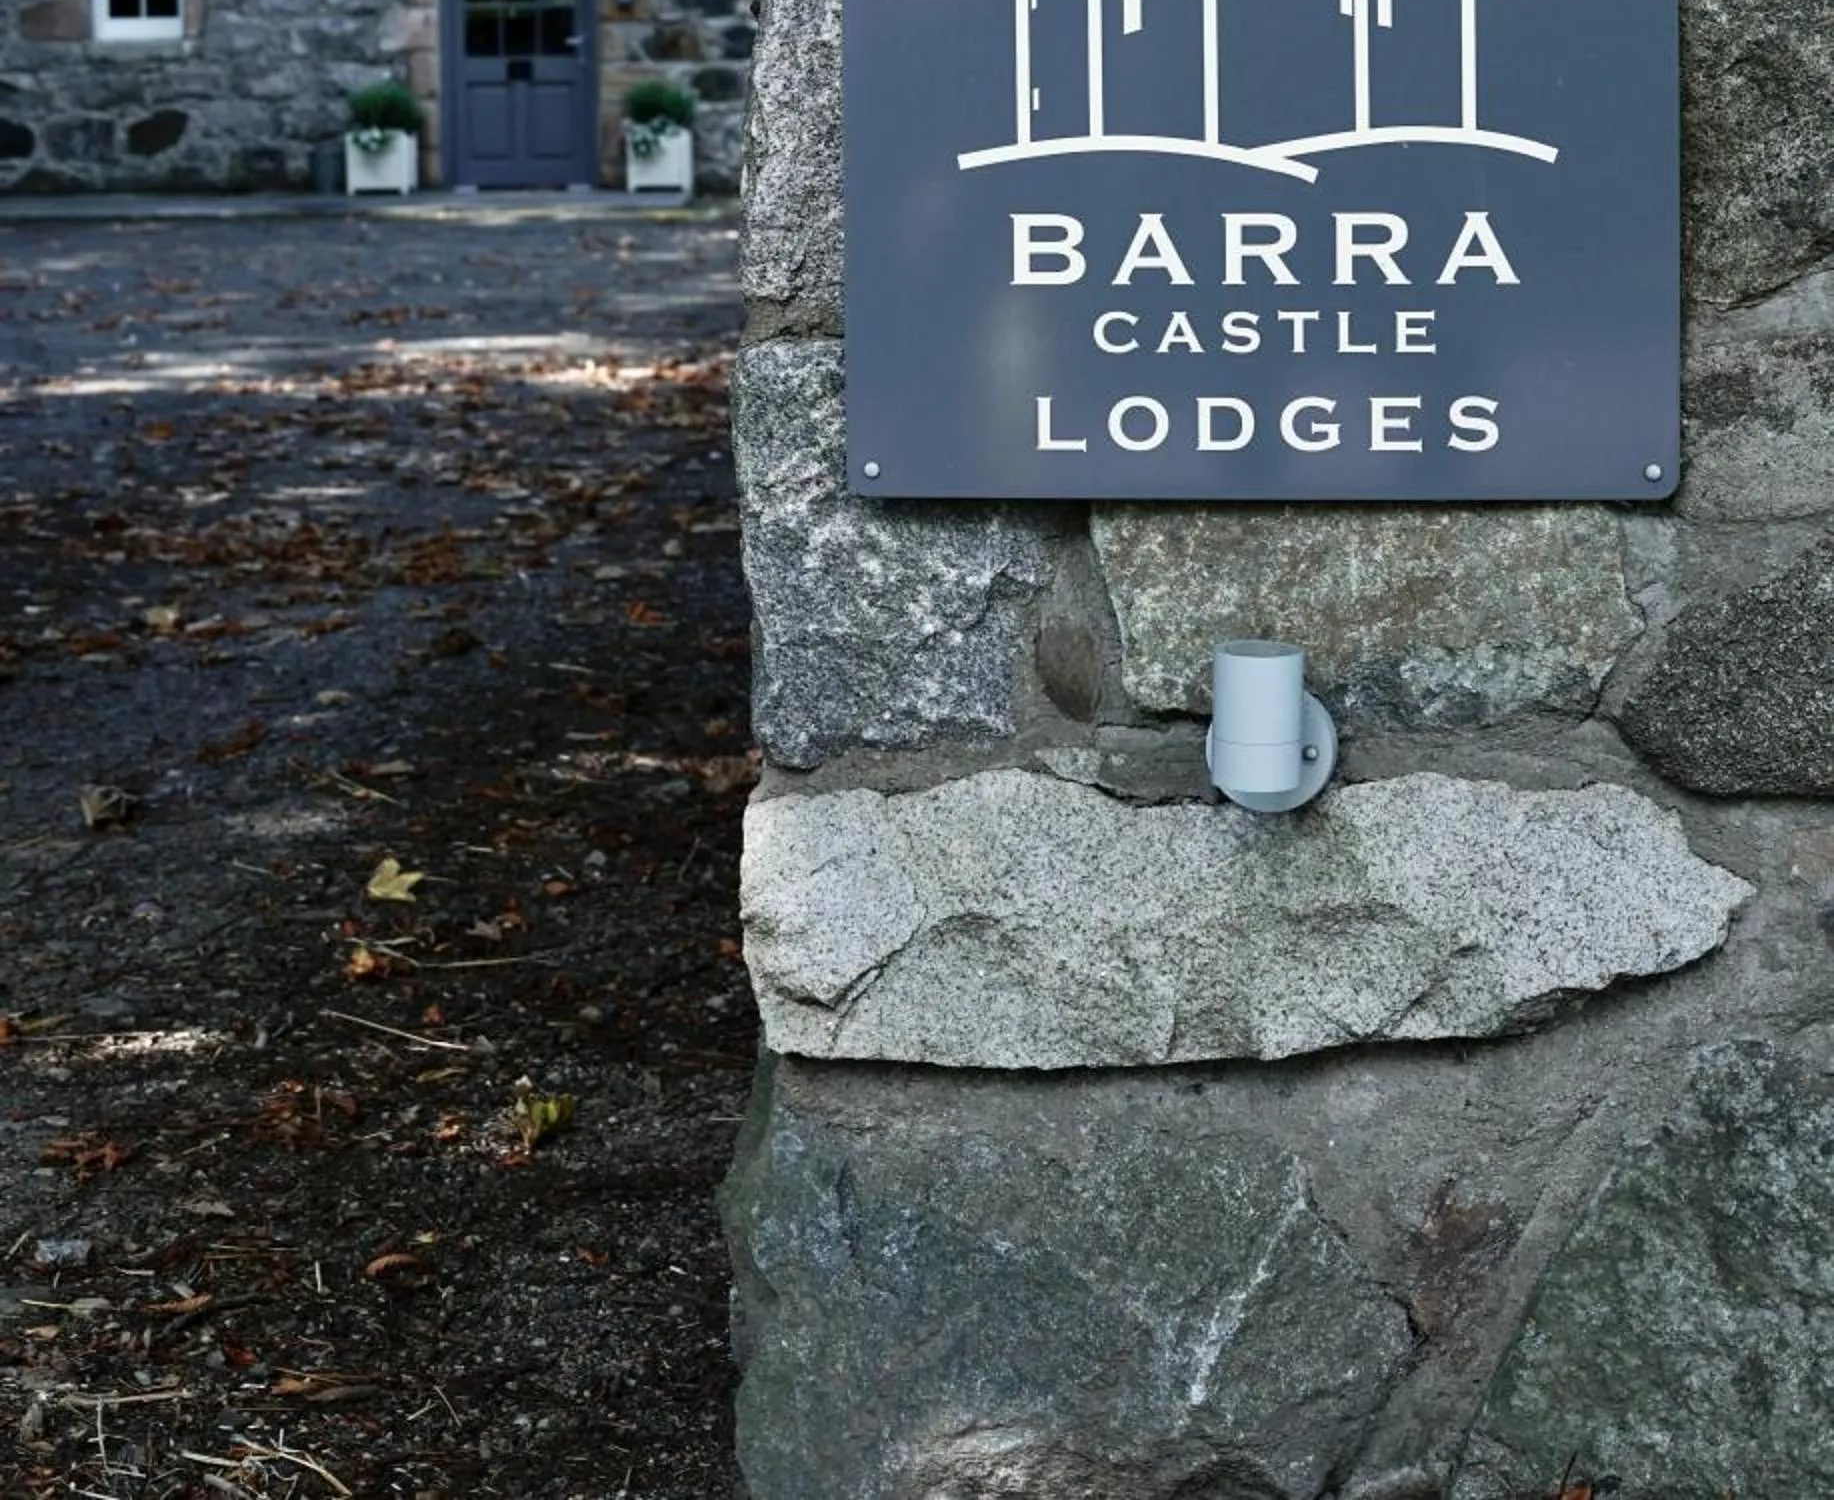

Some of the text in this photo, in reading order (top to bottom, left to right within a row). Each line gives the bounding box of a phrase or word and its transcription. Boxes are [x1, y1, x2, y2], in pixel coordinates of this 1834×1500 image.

[1009, 211, 1521, 286] BARRA
[1092, 310, 1437, 355] CASTLE
[1035, 395, 1501, 453] LODGES
